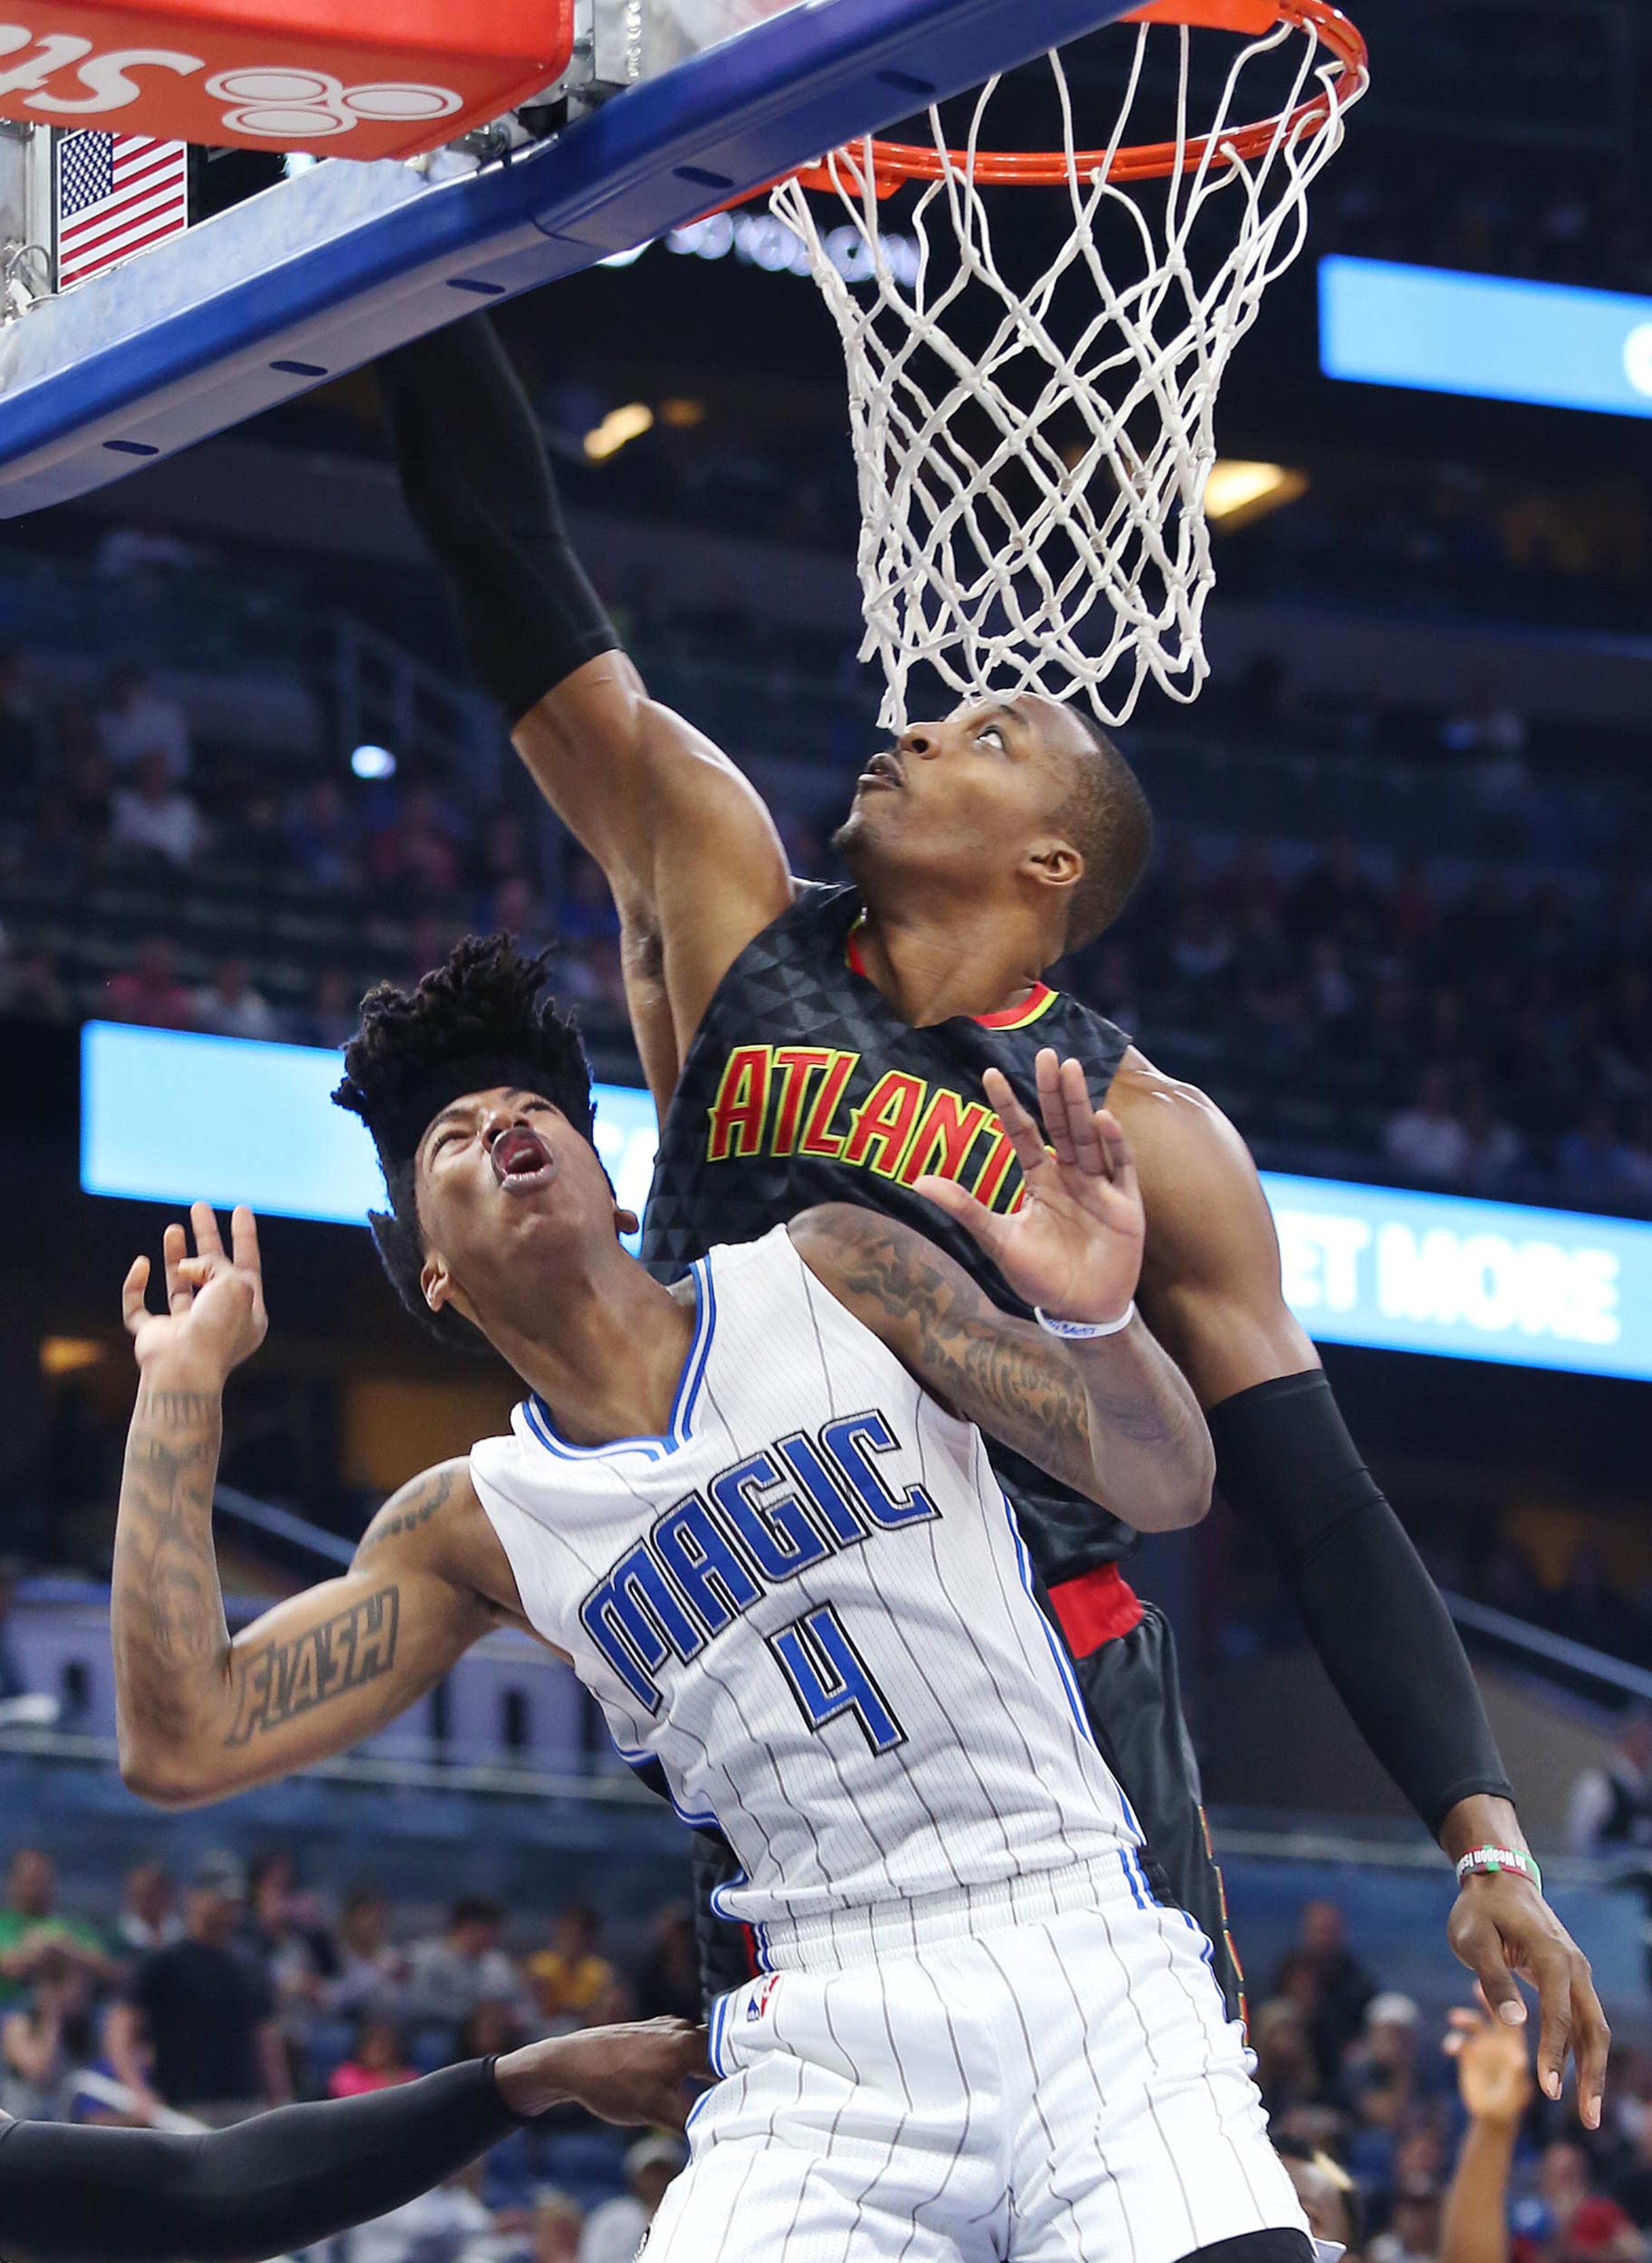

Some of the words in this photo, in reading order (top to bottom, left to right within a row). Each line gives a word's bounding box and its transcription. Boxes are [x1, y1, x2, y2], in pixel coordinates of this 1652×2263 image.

[0, 24, 206, 113] St
[707, 1044, 1057, 1214] ATLANT
[1274, 1208, 1371, 1313] ET
[1378, 1221, 1621, 1345] MORE
[579, 1409, 943, 1717] MAGIC
[223, 1583, 399, 1748] FLASH
[764, 1599, 909, 1758] 4
[1474, 1848, 1515, 1867] Weapon
